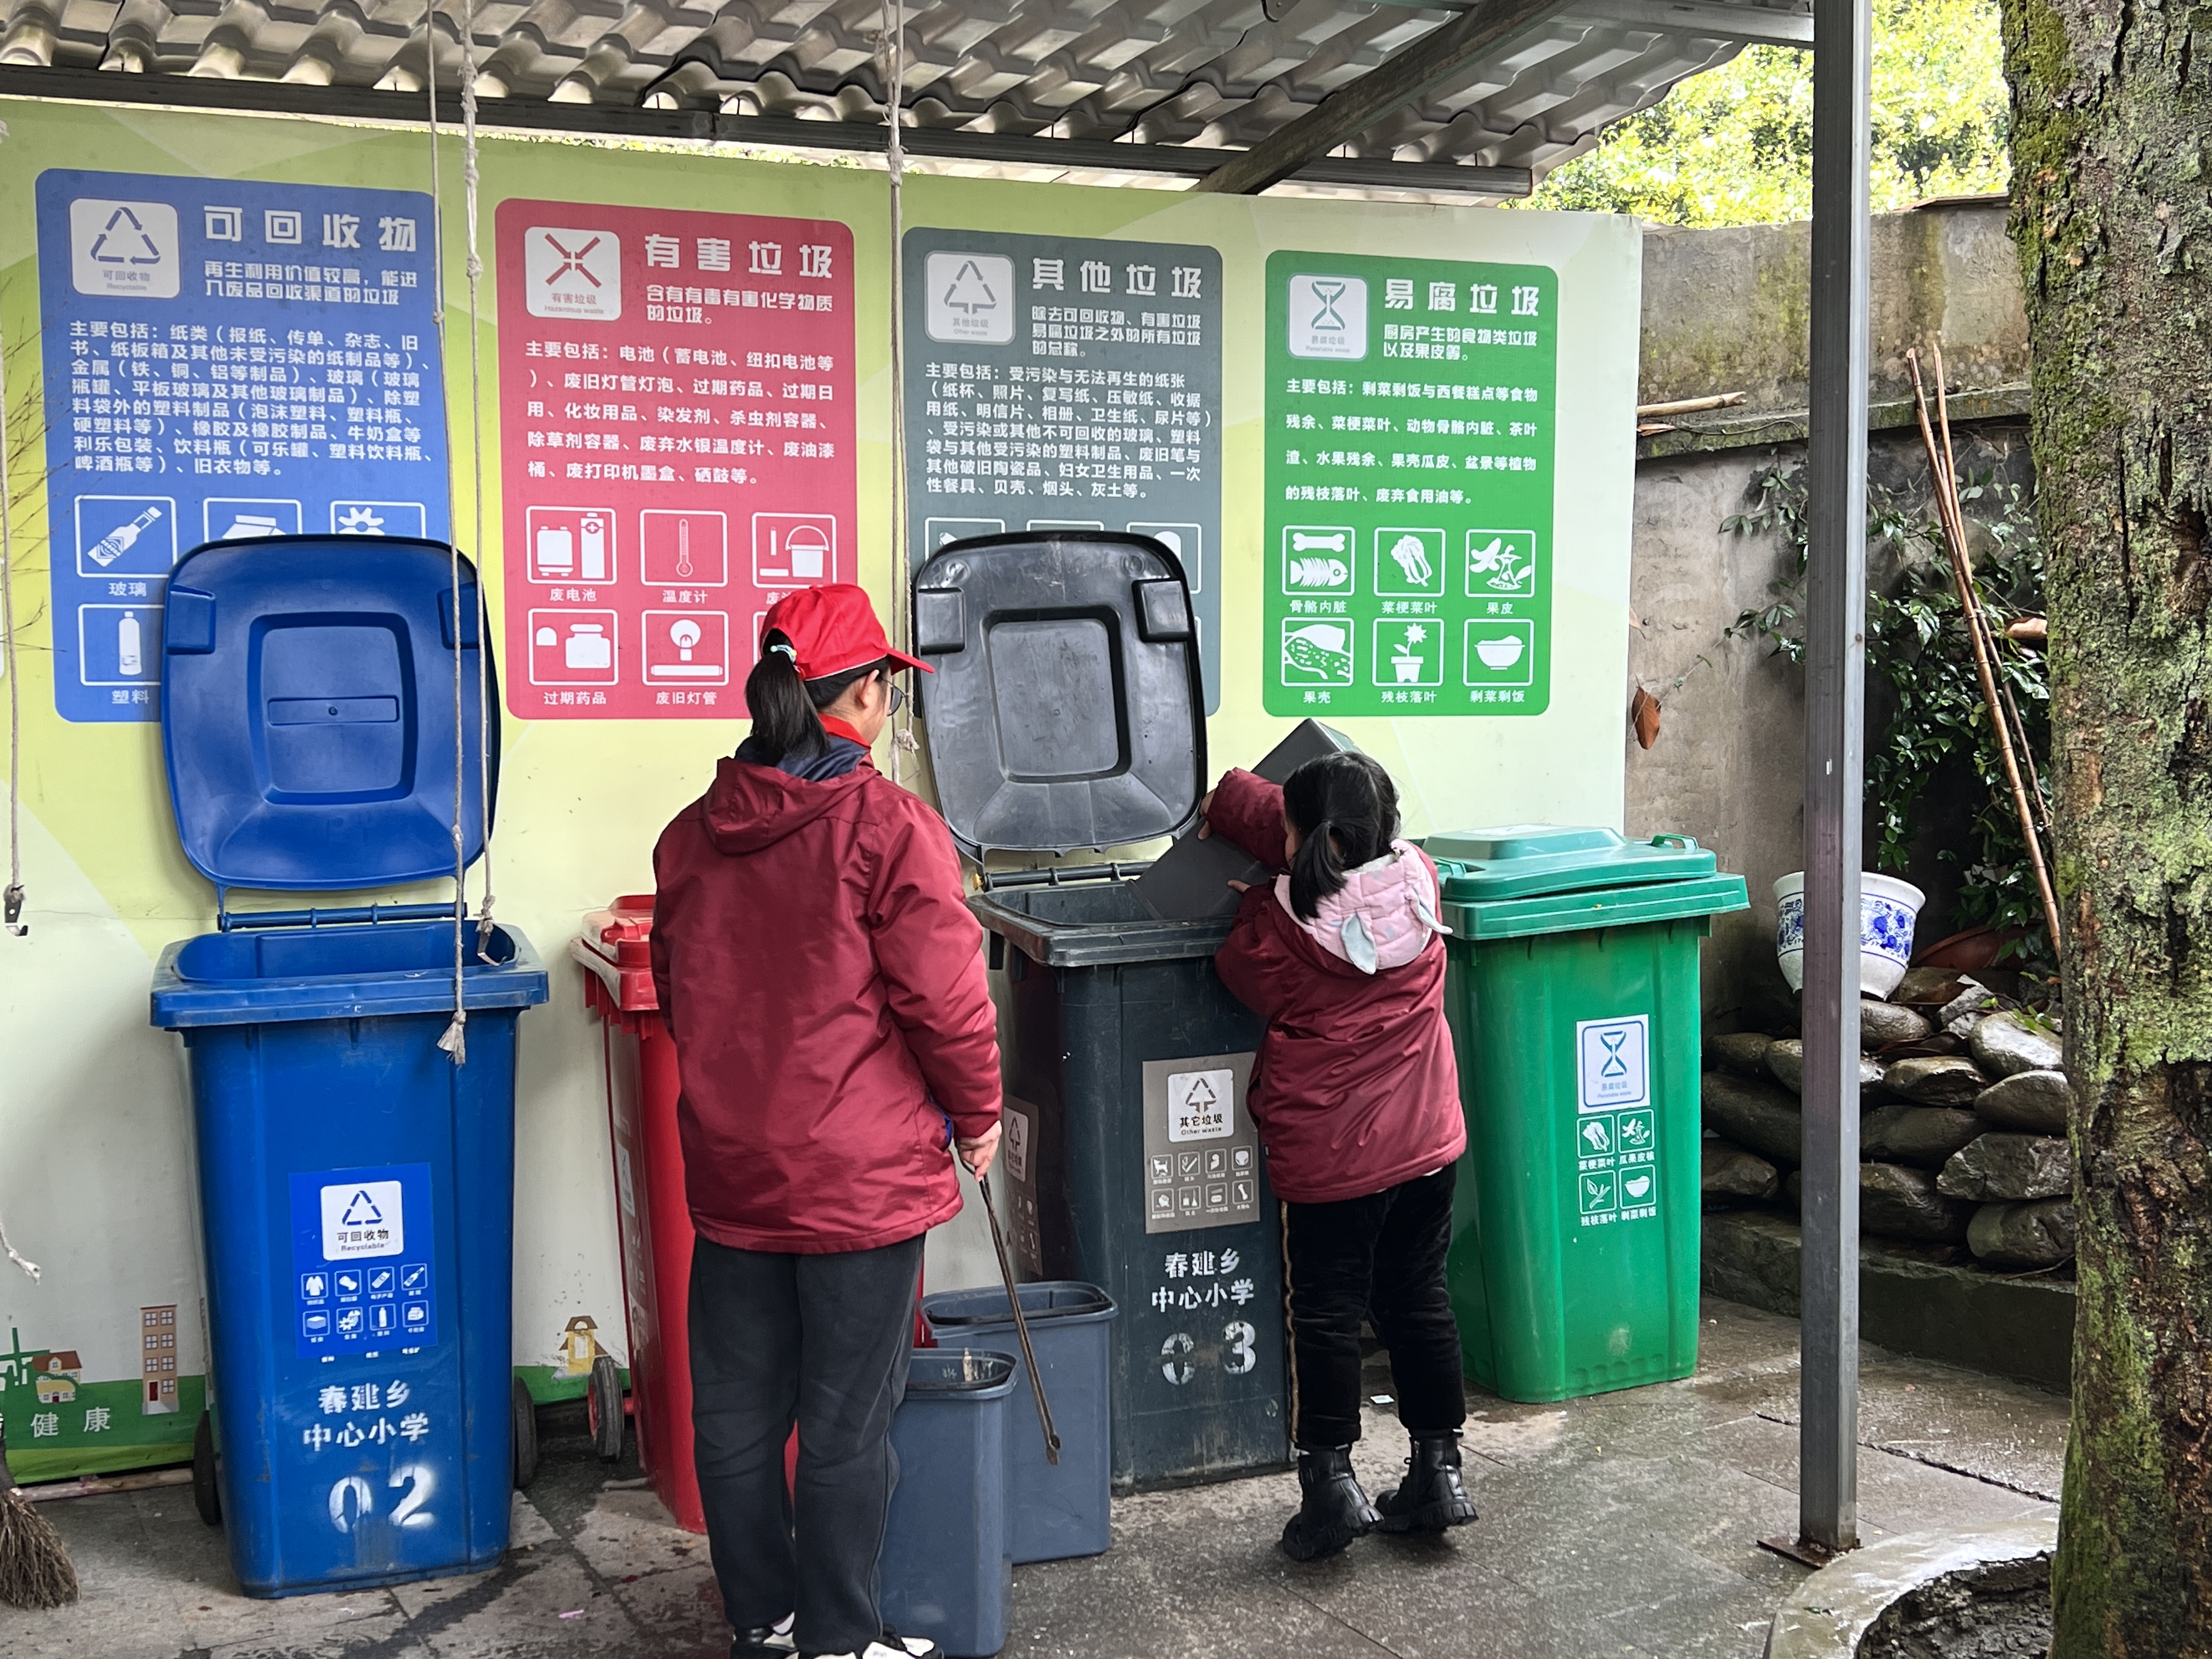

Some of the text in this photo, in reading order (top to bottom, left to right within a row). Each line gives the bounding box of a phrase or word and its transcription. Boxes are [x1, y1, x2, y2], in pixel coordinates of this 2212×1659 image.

[204, 205, 417, 252] 可回收物
[645, 234, 832, 278] 有害垃圾
[103, 270, 150, 281] 可回收物
[1032, 258, 1201, 299] 其他垃圾
[551, 292, 597, 304] 有害垃圾
[1384, 279, 1539, 317] 易腐垃圾
[647, 304, 712, 324] 的垃圾。
[1384, 324, 1537, 346] 厨房产生的食物类垃圾
[1032, 340, 1086, 357] 的总称。
[1383, 342, 1468, 361] 以及果皮等。
[926, 362, 1185, 388] 主要包括：受污染与无法再生的纸张
[1286, 379, 1538, 402] 主要包括：剩菜剩饭与西餐糕点等食物
[1285, 486, 1471, 504] 的残枝落叶、废弃食用油等。
[108, 582, 147, 597] 玻璃
[550, 588, 596, 602] 废电池
[662, 590, 708, 604] 温度计
[1381, 601, 1437, 614] 菜梗菜叶
[1486, 602, 1514, 614] 果皮
[111, 690, 149, 705] 塑料
[544, 691, 606, 706] 过期药品
[656, 691, 717, 706] 废旧灯管
[1303, 691, 1331, 704] 果壳
[1381, 691, 1437, 704] 残枝落叶
[1470, 690, 1525, 703] 剩菜剩饭
[1180, 1114, 1223, 1127] 其它垃圾
[337, 1229, 389, 1243] 可回收物
[341, 1242, 385, 1252] Recyclable
[1165, 1248, 1240, 1278] 春建乡
[1152, 1278, 1254, 1312] 中心小学
[318, 1379, 410, 1414] 春建乡
[303, 1412, 429, 1451] 中心小学
[329, 1464, 436, 1533] 02
